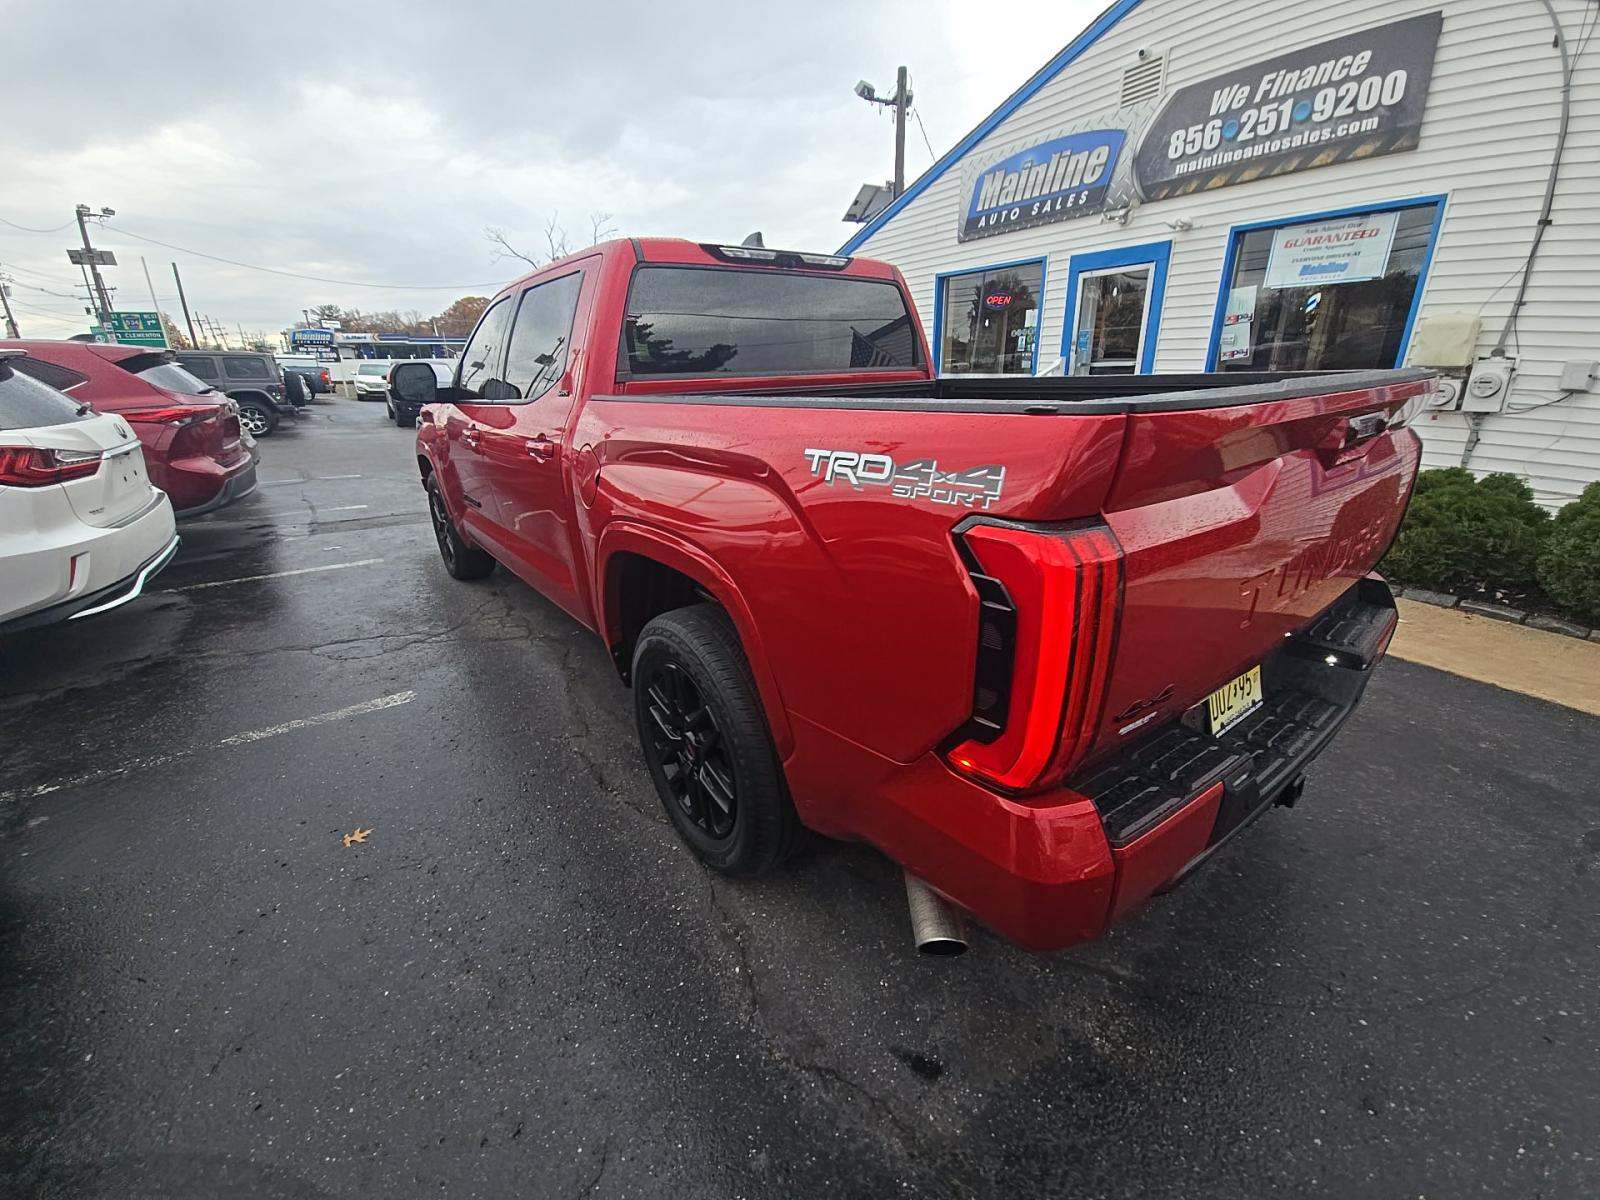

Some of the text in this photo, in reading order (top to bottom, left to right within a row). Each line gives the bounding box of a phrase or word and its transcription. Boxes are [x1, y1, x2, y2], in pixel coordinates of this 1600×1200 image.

[1210, 50, 1373, 117] We Finance
[1174, 115, 1380, 175] mainlineautosales.com
[976, 144, 1110, 212] Mainline
[978, 190, 1089, 228] AUTO SALES
[1283, 228, 1381, 249] GUARANTEED
[986, 295, 1012, 305] OPEN
[804, 448, 896, 489] TRD
[892, 484, 1001, 510] SPORT
